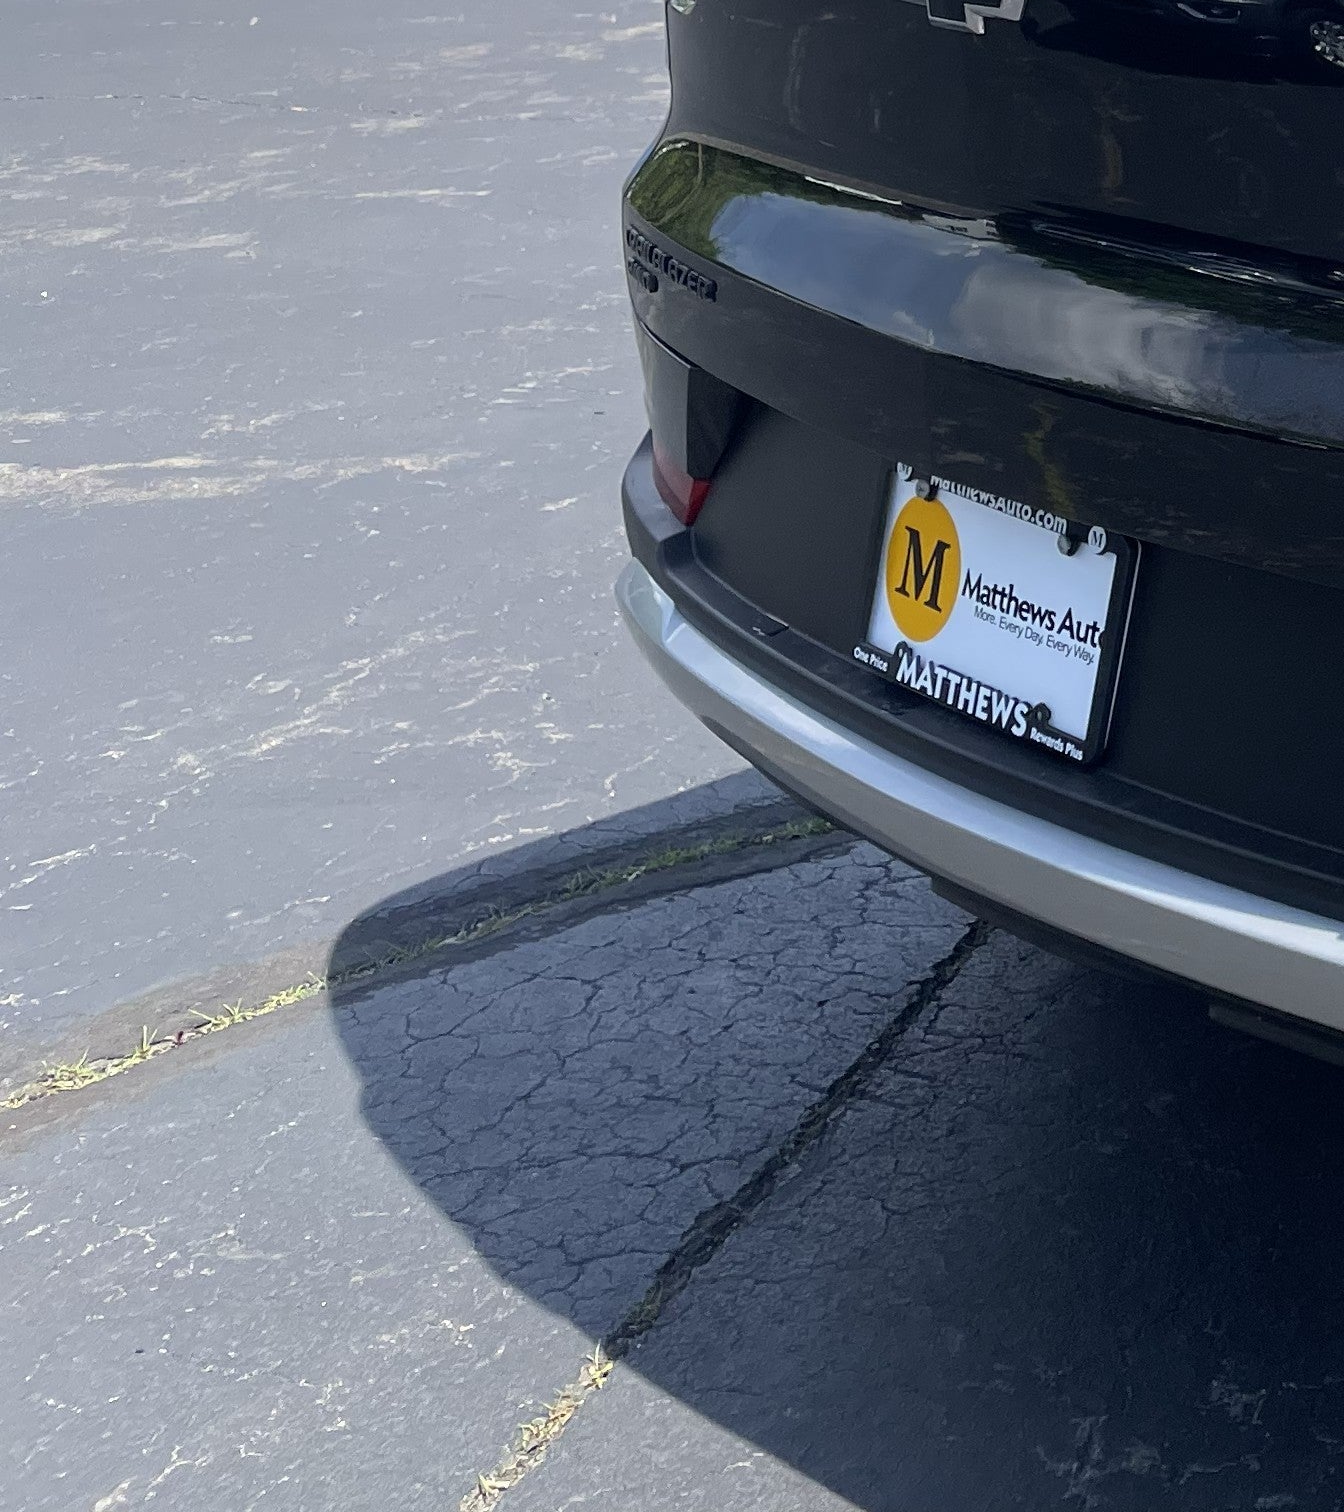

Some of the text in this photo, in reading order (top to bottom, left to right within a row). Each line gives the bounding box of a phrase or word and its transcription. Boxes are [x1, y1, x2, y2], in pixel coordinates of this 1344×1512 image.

[894, 525, 951, 614] M
[961, 568, 1056, 632] Matthews
[853, 646, 888, 672] One Price
[974, 605, 997, 626] More.
[999, 616, 1024, 638] Every
[1046, 634, 1072, 657] Every
[896, 652, 1030, 737] MATTHEWS
[1030, 726, 1083, 761] Rewards Plus
